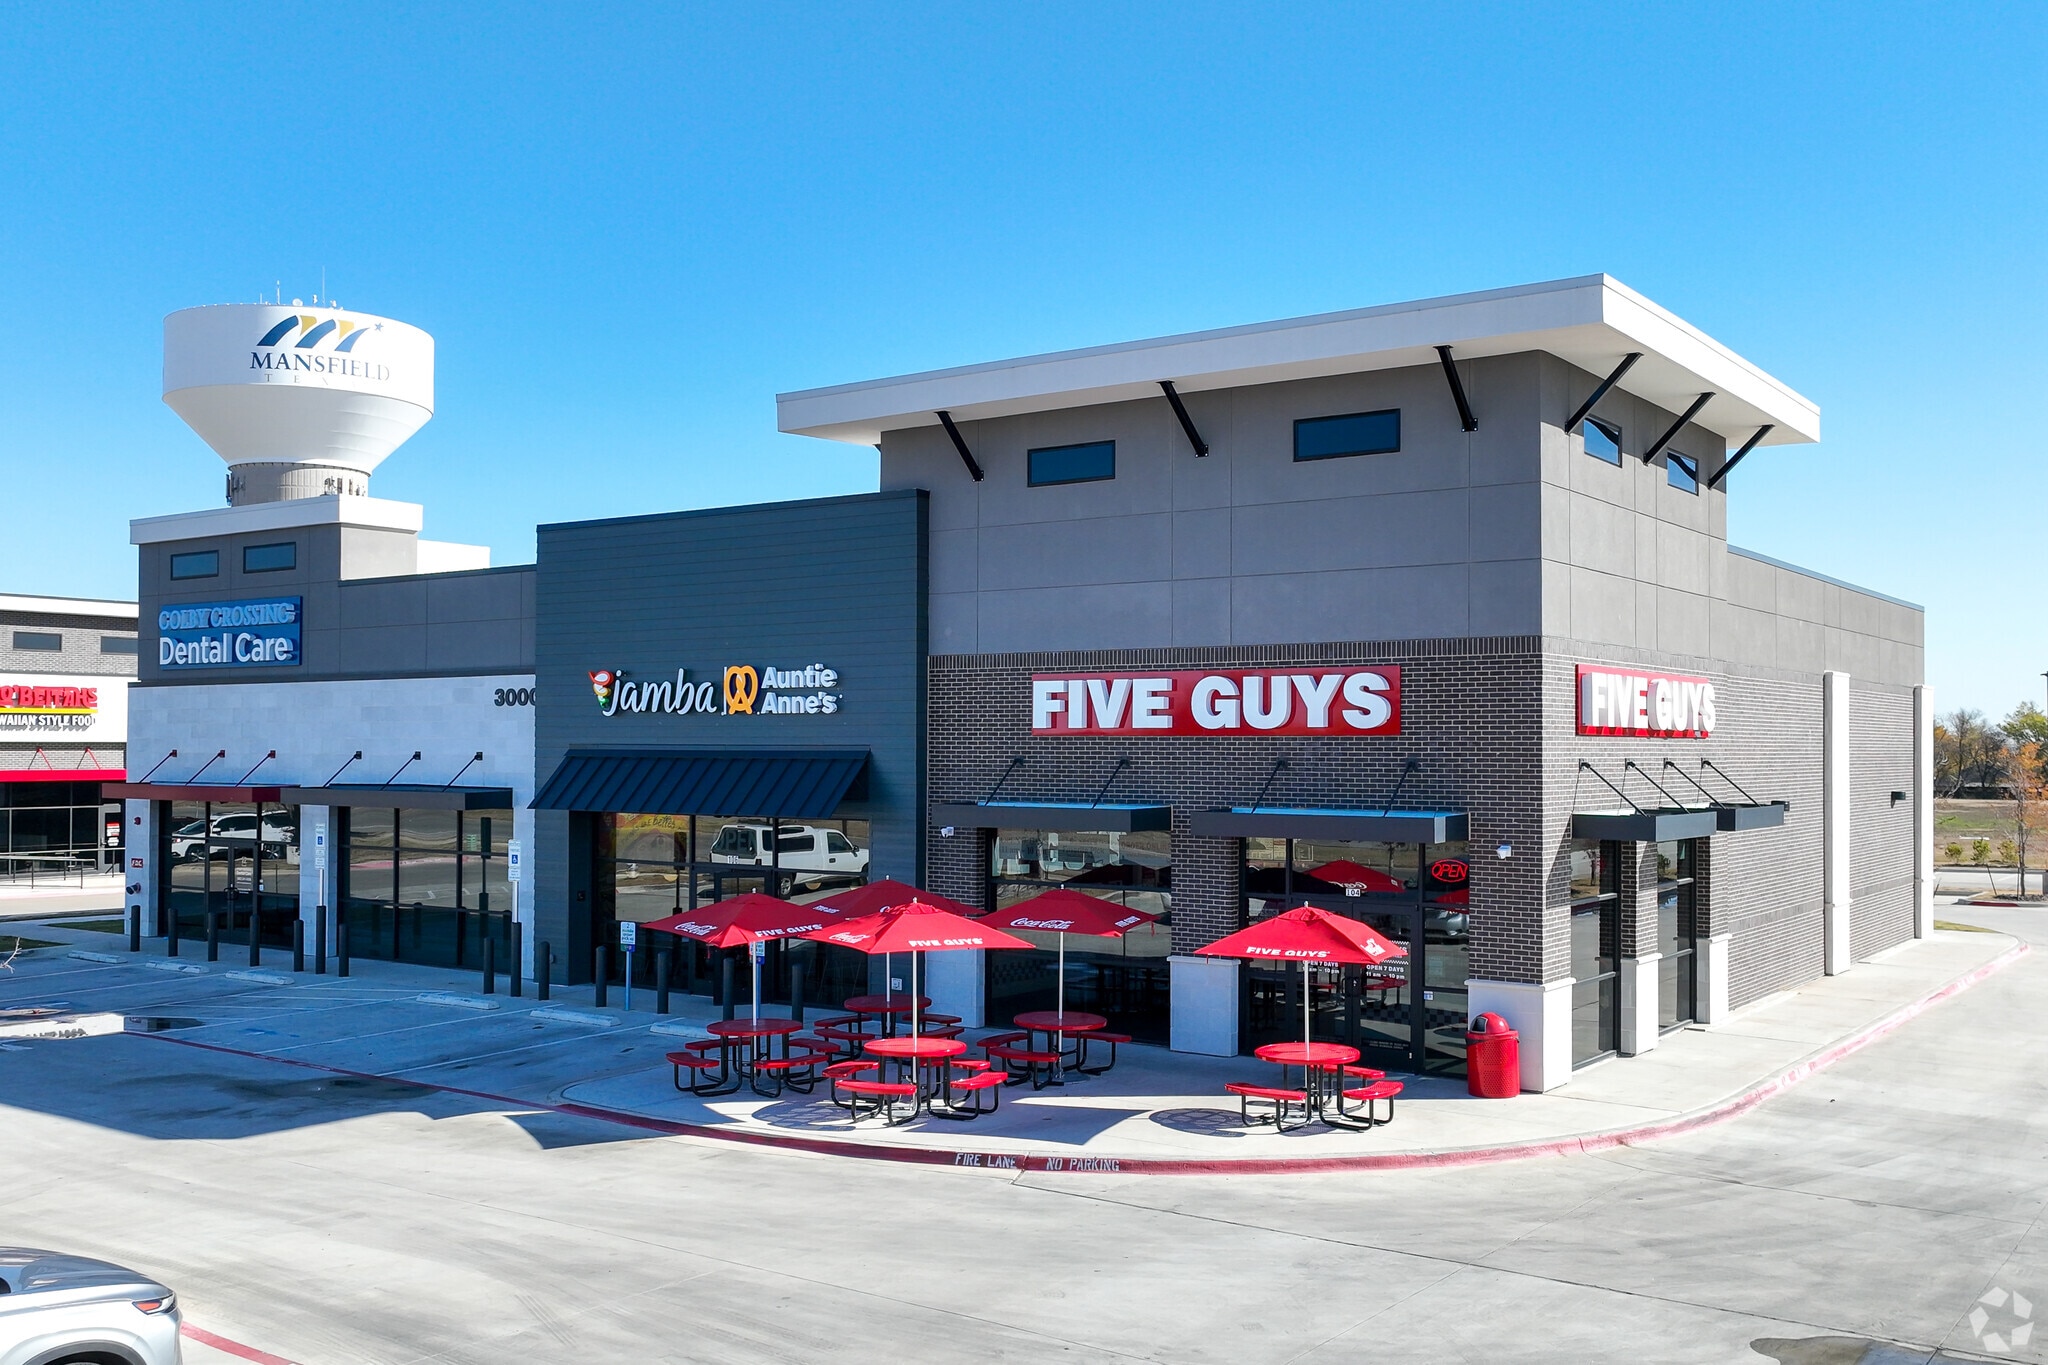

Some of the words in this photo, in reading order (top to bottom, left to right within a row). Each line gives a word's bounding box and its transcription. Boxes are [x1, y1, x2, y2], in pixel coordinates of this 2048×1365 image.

[249, 351, 390, 381] MANSFIELD
[158, 608, 211, 630] COLBY
[211, 602, 295, 628] CROSSING
[159, 633, 231, 665] Dental
[235, 633, 292, 662] Care
[761, 663, 837, 689] Auntie
[602, 668, 717, 717] jamba
[760, 691, 837, 715] Anne's
[1032, 678, 1176, 730] FIVE
[1191, 672, 1392, 731] GUYS
[1583, 672, 1649, 729] FIVE
[1649, 678, 1716, 732] GUYS
[38, 715, 70, 726] STYLE
[1433, 863, 1468, 878] OPEN
[755, 928, 785, 938] FIVE
[787, 924, 822, 933] GUYS
[908, 938, 941, 947] FIVE
[943, 937, 983, 946] GUYS
[1245, 946, 1282, 955] FIVE
[1284, 949, 1329, 958] GUYS
[954, 1152, 982, 1167] FIRE
[987, 1155, 1017, 1169] LANE
[1046, 1157, 1063, 1171] NO
[1069, 1158, 1120, 1172] PARKING
